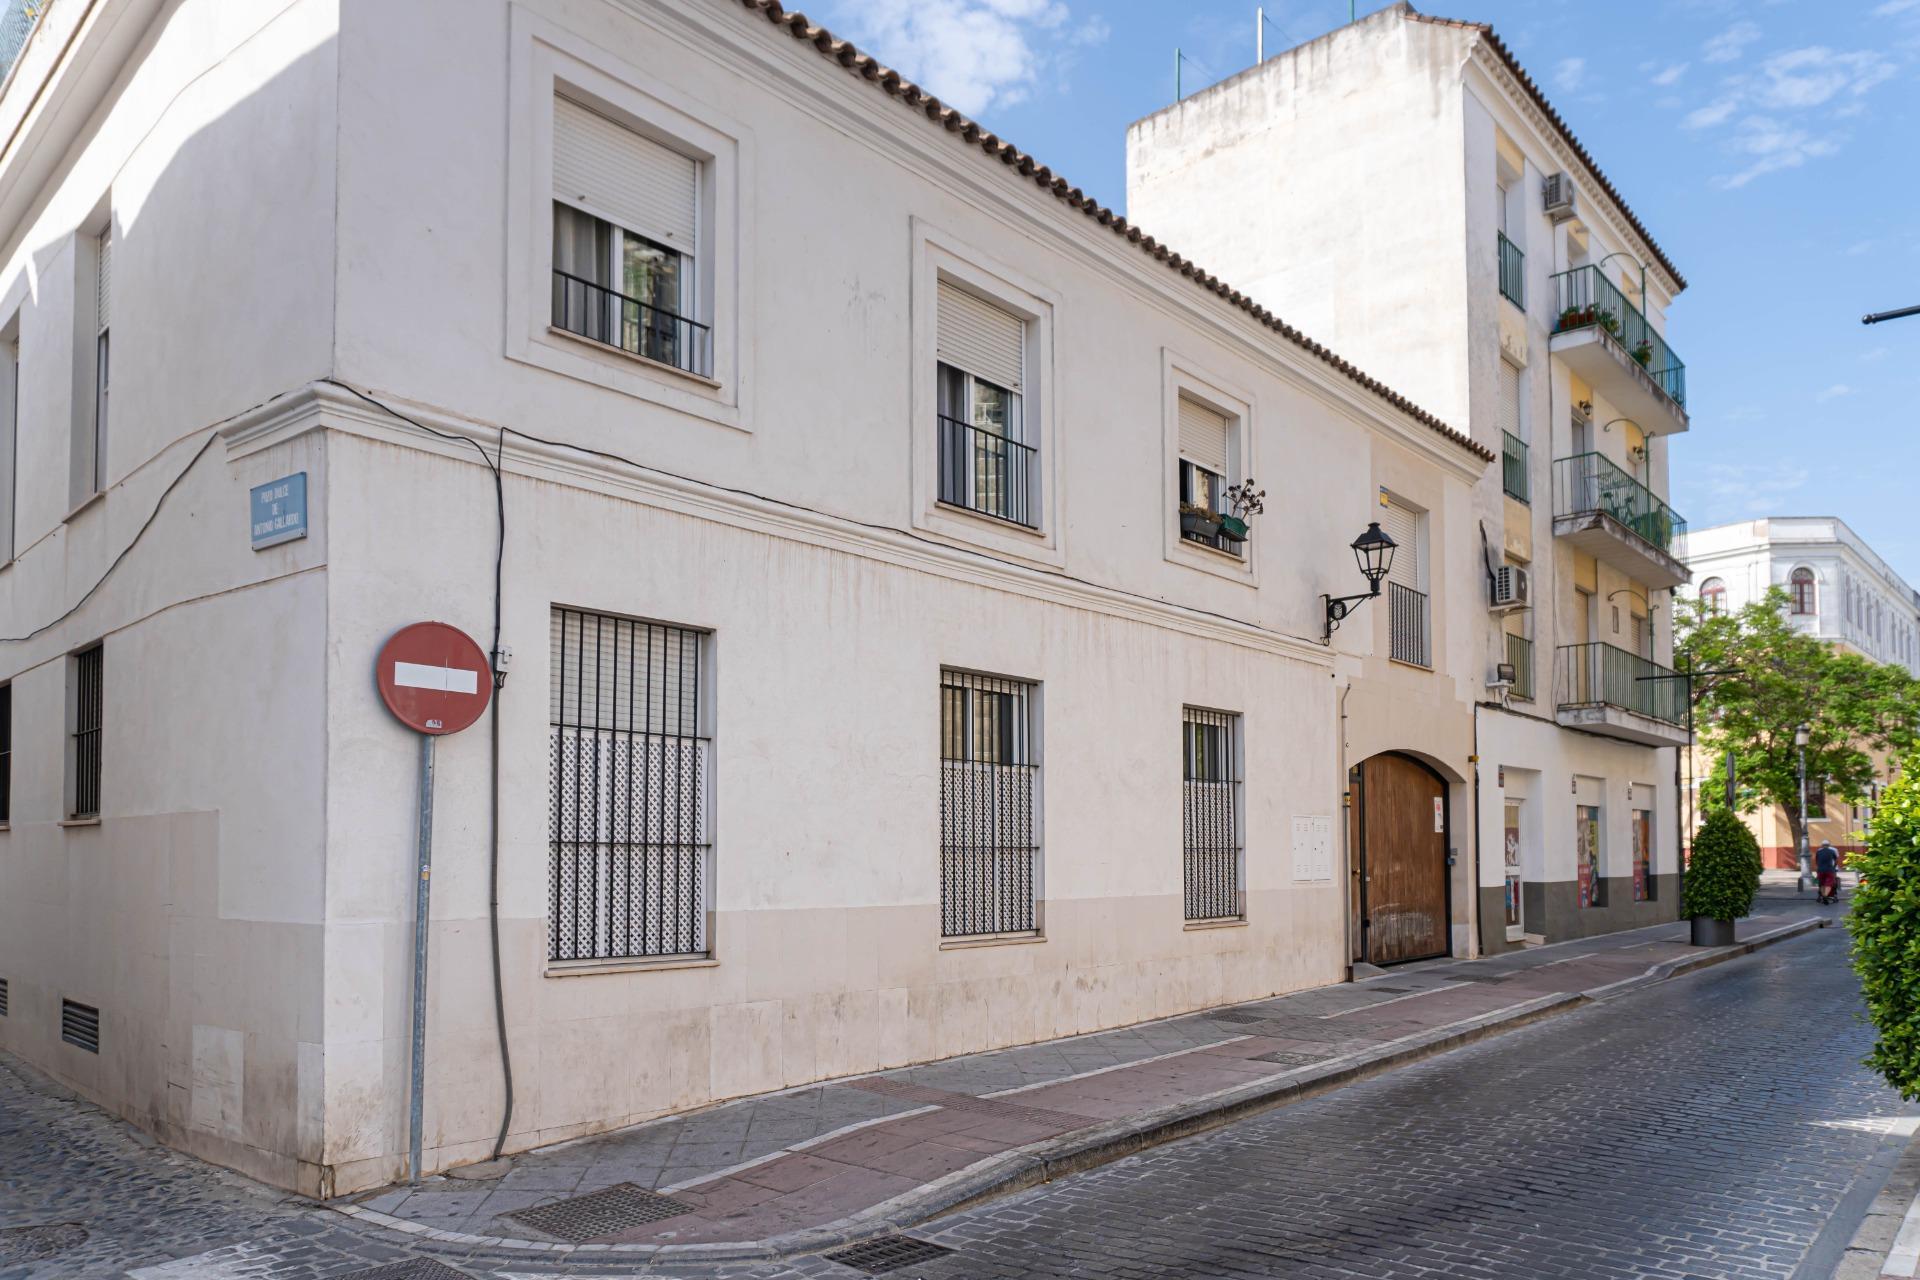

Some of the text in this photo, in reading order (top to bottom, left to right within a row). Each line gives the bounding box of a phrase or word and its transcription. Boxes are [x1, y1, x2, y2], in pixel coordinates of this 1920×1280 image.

[272, 502, 280, 515] DE
[254, 512, 299, 537] ANTONIO GALLARDO
